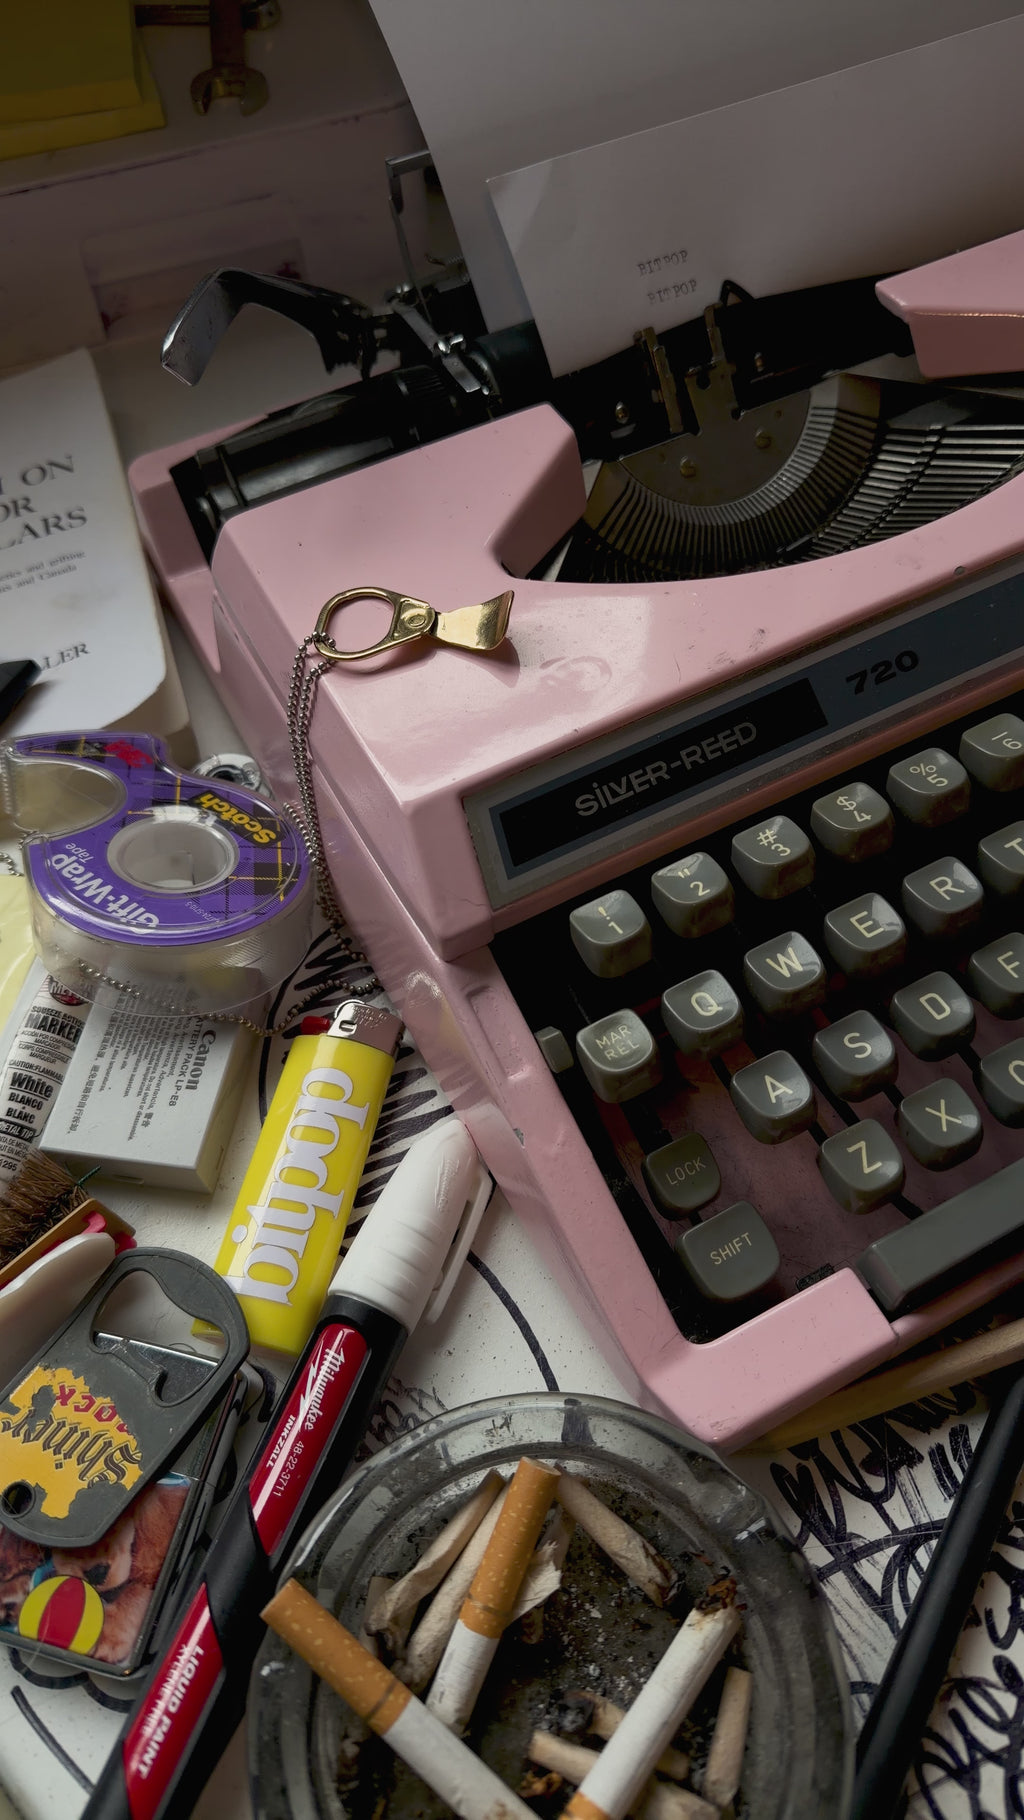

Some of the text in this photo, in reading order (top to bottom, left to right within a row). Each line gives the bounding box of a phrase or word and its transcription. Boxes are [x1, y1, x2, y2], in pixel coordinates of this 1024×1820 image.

[20, 454, 75, 487] ON
[40, 643, 90, 671] LER
[846, 650, 920, 695] 720
[1002, 738, 1022, 750] 6
[909, 763, 937, 776] %
[928, 773, 948, 788] 5
[836, 795, 857, 811] $
[854, 810, 871, 823] 4
[199, 793, 278, 844] Scotch
[756, 828, 778, 847] #
[770, 841, 791, 856] 3
[1004, 838, 1024, 856] T
[65, 842, 94, 864] Tape
[51, 853, 160, 928] Gift-Wrap
[689, 881, 711, 896] 2
[928, 875, 965, 901] R
[607, 922, 623, 936] 1
[849, 910, 885, 938] E
[765, 947, 804, 978] W
[997, 951, 1021, 979] F
[31, 1006, 62, 1019] SQUEEZE
[690, 992, 723, 1017] Q
[918, 992, 952, 1022] D
[594, 1025, 632, 1049] MAR
[605, 1039, 640, 1061] REL
[843, 1032, 873, 1059] S
[177, 1052, 193, 1078] PACK
[186, 1029, 217, 1091] Canon
[10, 1072, 54, 1098] White
[168, 1078, 186, 1107] LP-E8
[764, 1075, 794, 1105] A
[8, 1092, 44, 1111] BLANCO
[6, 1107, 36, 1124] BLANC
[924, 1099, 963, 1132] X
[21, 1128, 33, 1139] TIP
[665, 1156, 707, 1187] LOCK
[846, 1141, 884, 1175] Z
[224, 1067, 371, 1307] bitpop
[709, 1231, 753, 1266] SHIFT
[304, 1348, 345, 1431] Milwaukee
[1, 1413, 143, 1489] Shiner
[266, 1415, 296, 1468] INKZALL
[272, 1440, 305, 1497] 48-22-3711
[137, 1646, 205, 1780] LIQUID PAINT
